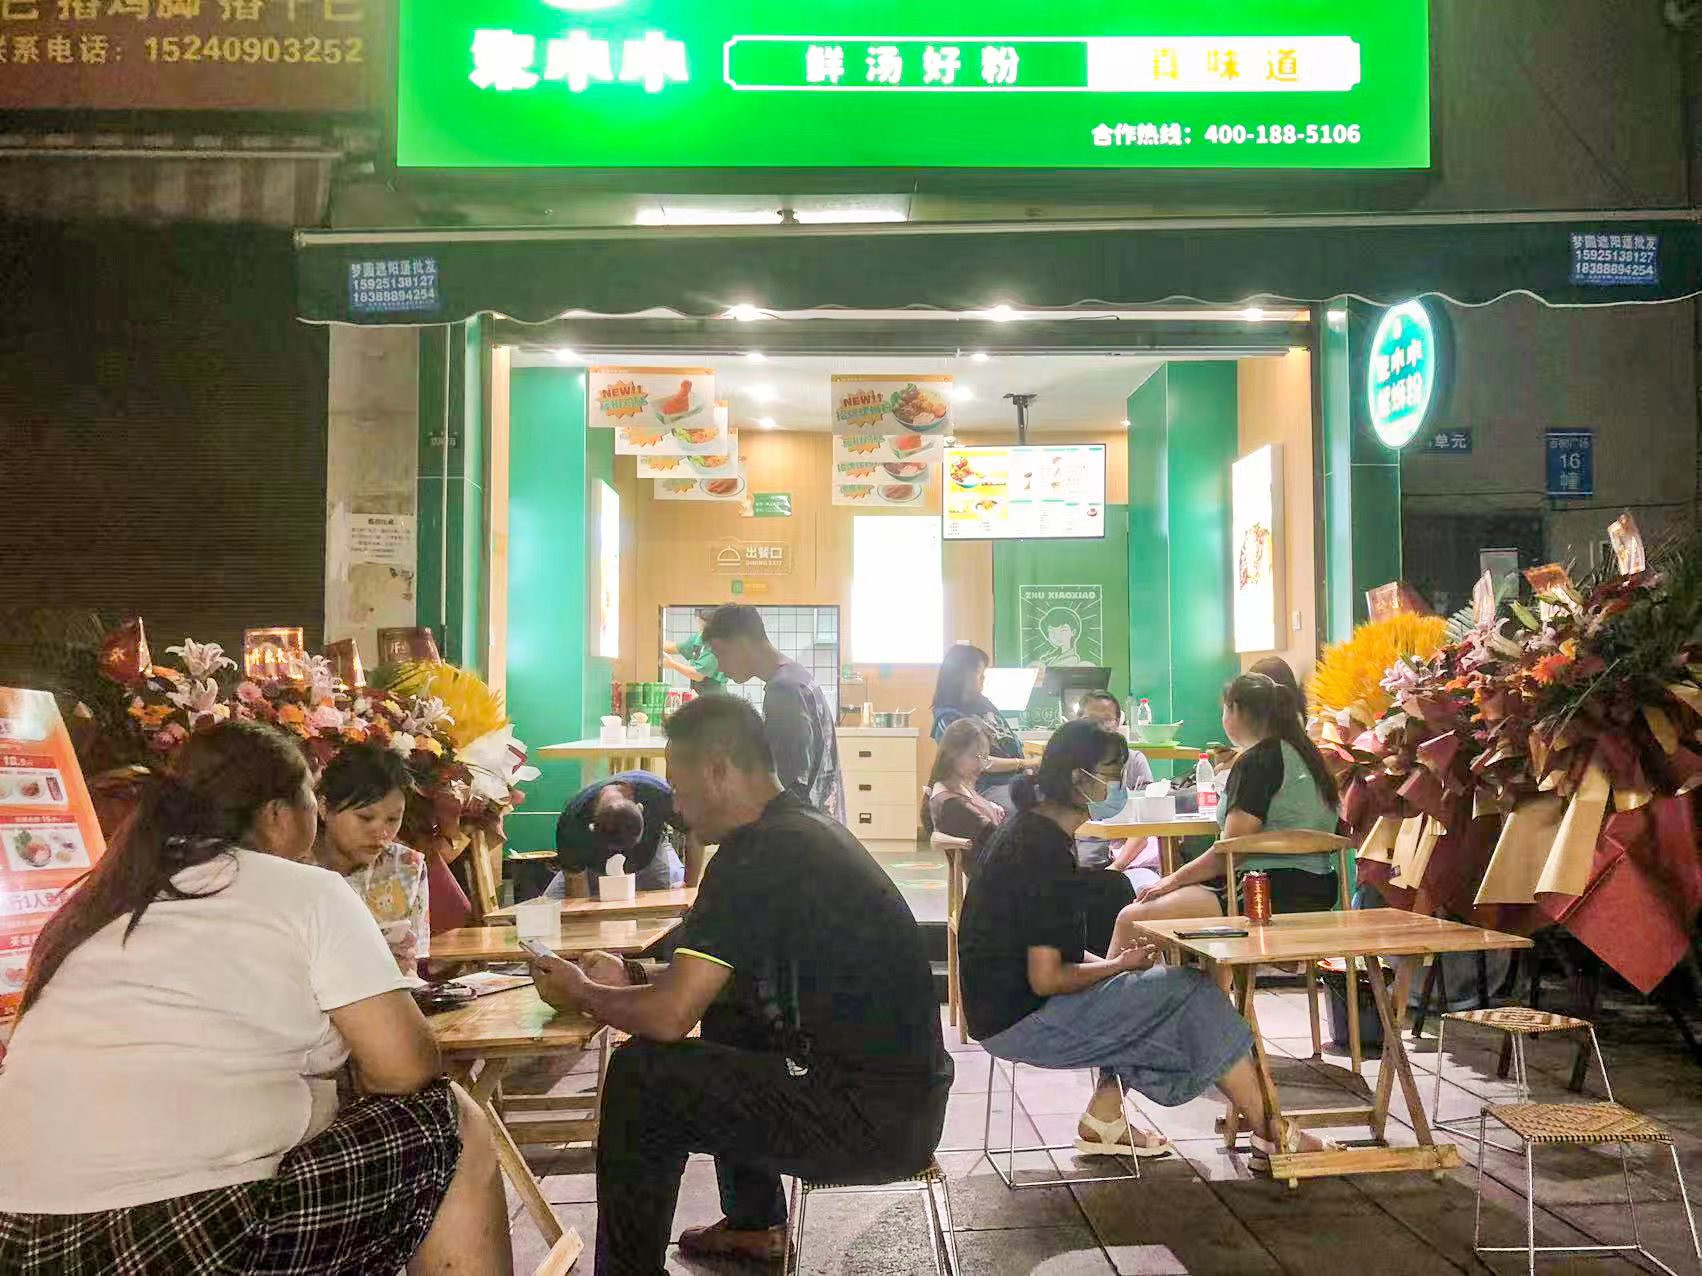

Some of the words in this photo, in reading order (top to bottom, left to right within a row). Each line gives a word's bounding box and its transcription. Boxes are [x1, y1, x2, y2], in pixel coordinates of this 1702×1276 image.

[144, 35, 363, 63] 15240903252
[805, 44, 1020, 84] 鲜汤好粉
[1203, 124, 1362, 145] 400-188-5106
[1576, 250, 1655, 262] 15925138127
[353, 275, 435, 290] 15925138127
[1560, 453, 1581, 468] 16
